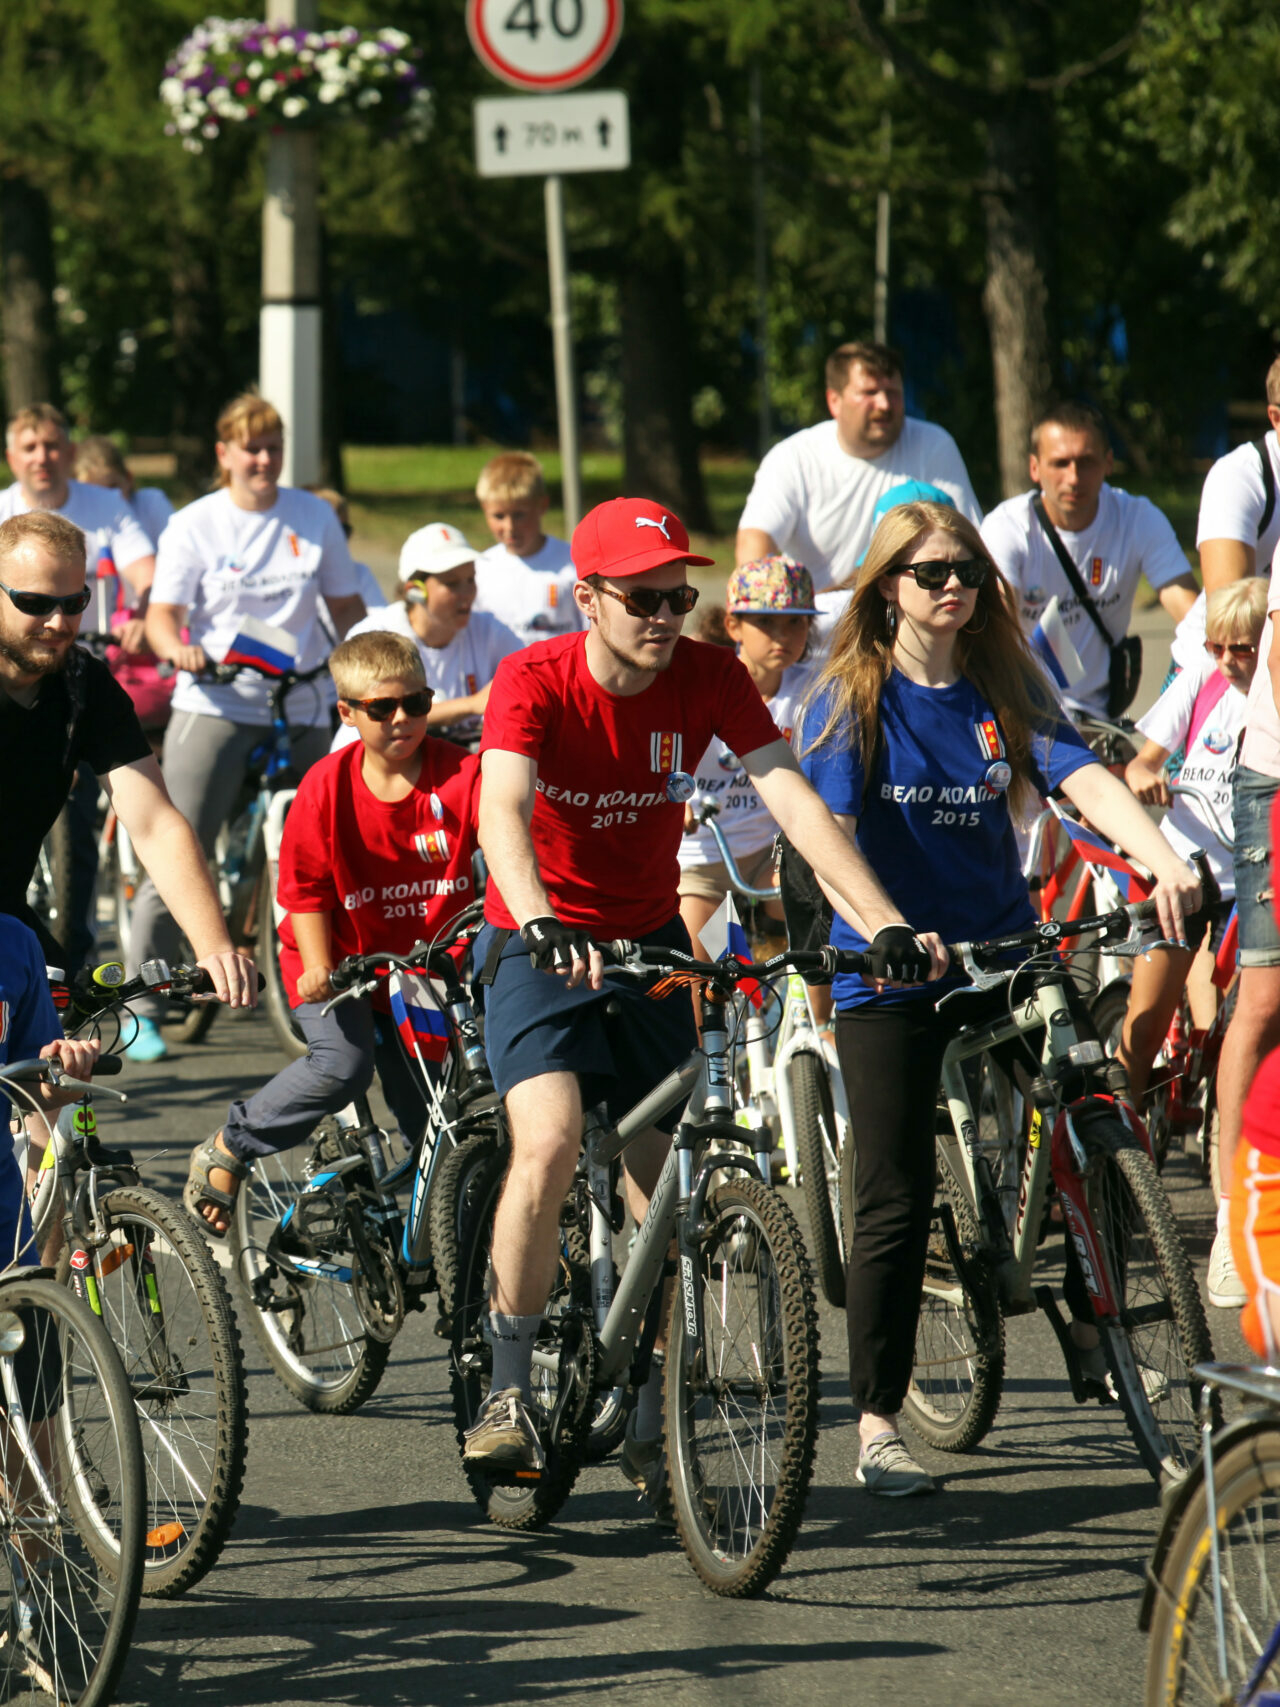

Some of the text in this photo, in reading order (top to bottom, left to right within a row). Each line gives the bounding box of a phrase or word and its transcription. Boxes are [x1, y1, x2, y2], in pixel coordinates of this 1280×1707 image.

[504, 0, 584, 41] 40
[523, 121, 558, 147] 70
[1183, 768, 1215, 781] ВЕЛО
[697, 777, 725, 791] ВЕЛ
[535, 778, 667, 809] ВЕЛО КОЛПИ
[880, 783, 933, 803] ВЕЛО
[1213, 790, 1230, 804] 20
[725, 795, 758, 810] 2015
[590, 811, 638, 829] 2015
[931, 810, 980, 826] 2015
[383, 902, 428, 919] 2015
